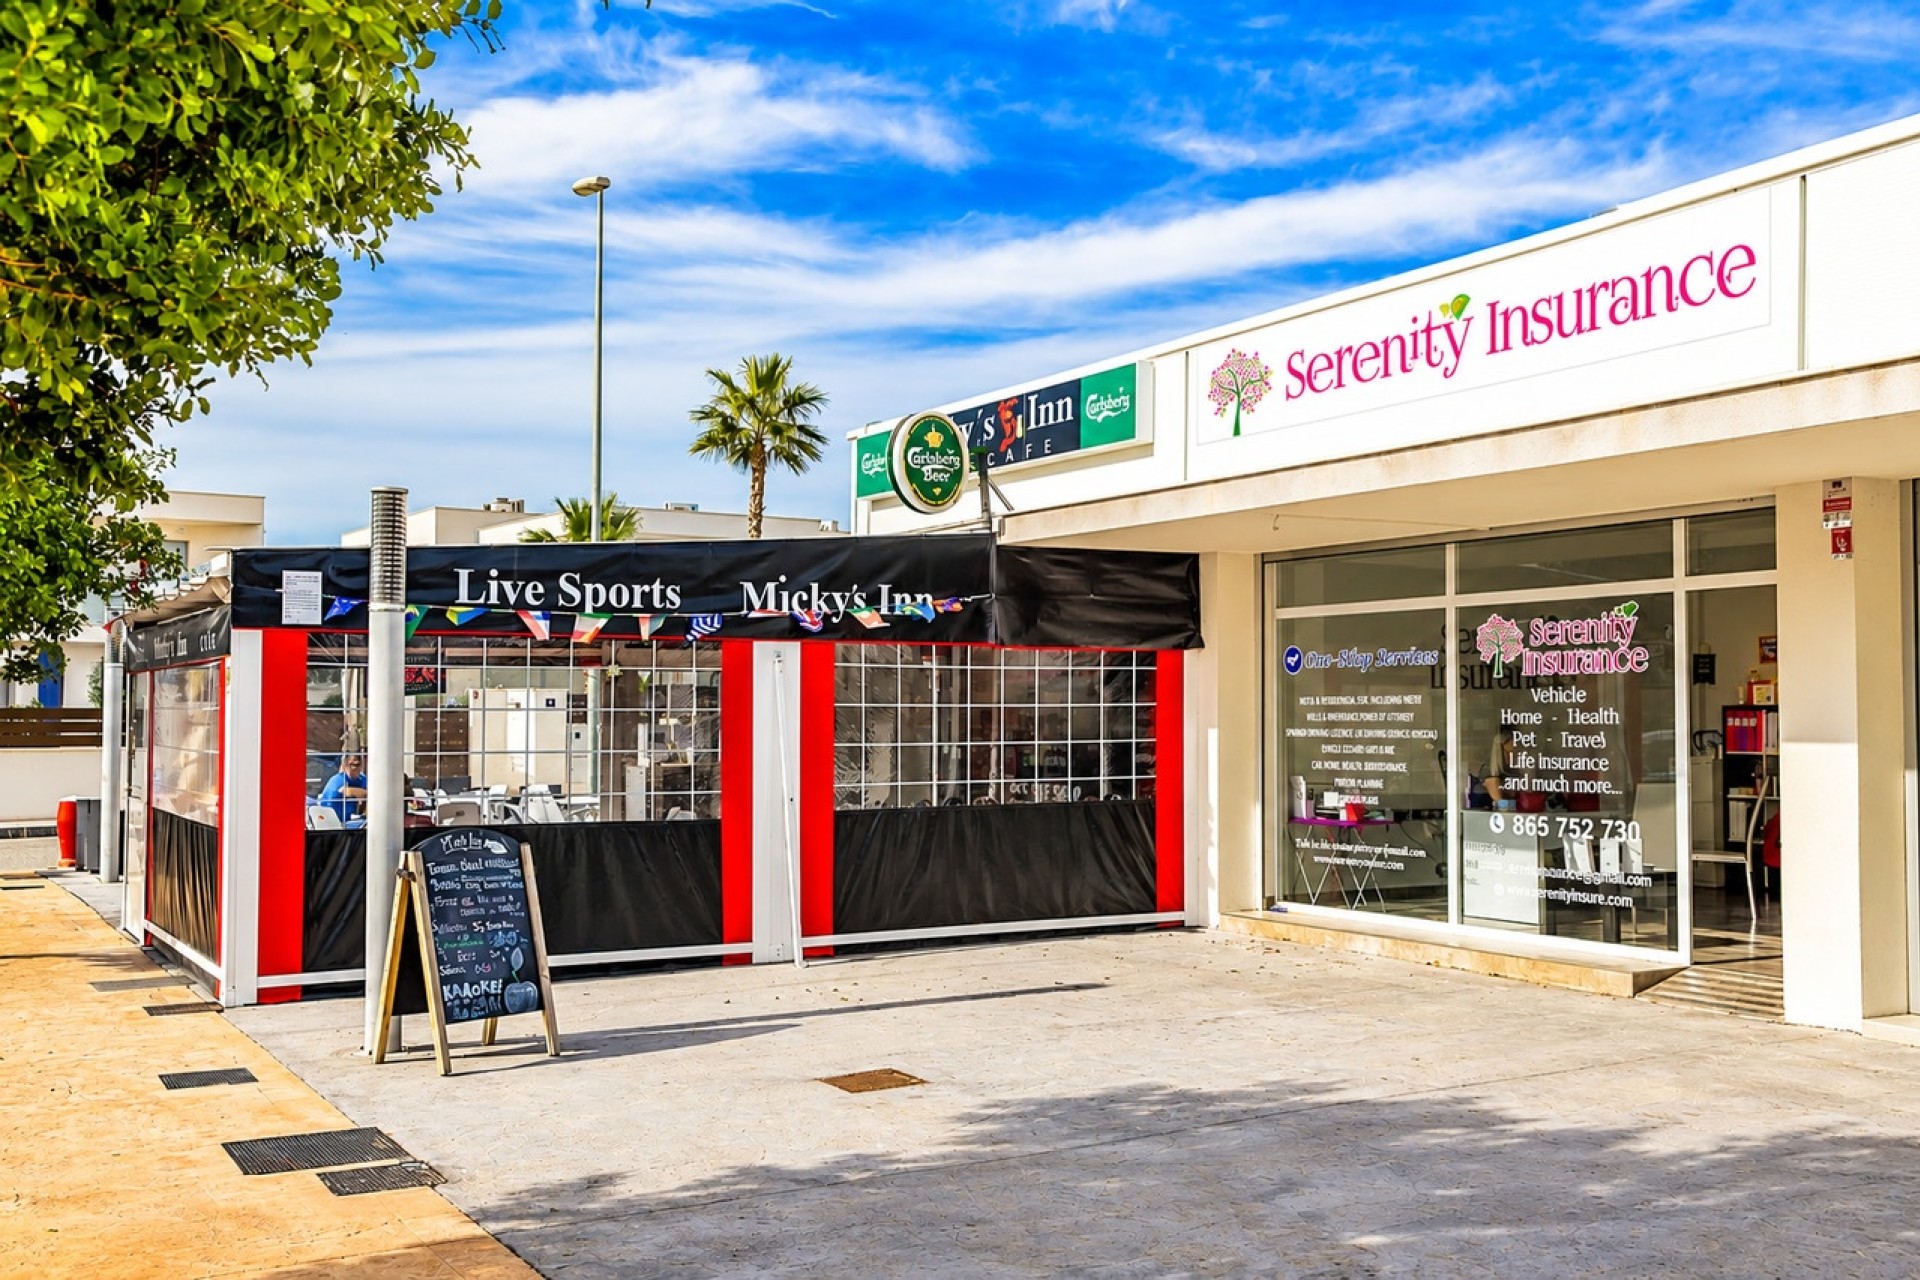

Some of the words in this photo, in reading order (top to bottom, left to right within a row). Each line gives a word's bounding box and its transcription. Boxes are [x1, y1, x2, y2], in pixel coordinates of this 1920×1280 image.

[1285, 309, 1474, 401] Serenity
[1486, 244, 1757, 355] Insurance
[1027, 395, 1073, 430] Inn
[1086, 387, 1130, 422] Carlsberg
[907, 446, 960, 470] Carlsberg
[987, 438, 1052, 466] CAFE
[923, 467, 953, 482] Beer
[453, 568, 545, 606] Live
[557, 572, 681, 613] Sports
[739, 574, 867, 623] Micky's
[1529, 610, 1639, 648] Serenity
[1375, 645, 1439, 667] Services
[1521, 646, 1649, 676] Insurance
[1531, 686, 1587, 703] Vehicle
[1501, 708, 1543, 725] Home
[1567, 707, 1620, 725] Health
[1512, 730, 1537, 747] Pet
[1560, 731, 1606, 749] Travel
[1509, 751, 1535, 769] Life
[1539, 752, 1610, 771] Insurance
[1532, 774, 1570, 793] much
[1574, 779, 1623, 795] more...
[1512, 814, 1549, 837] 865
[1555, 817, 1594, 840] 752
[1600, 818, 1641, 843] 730
